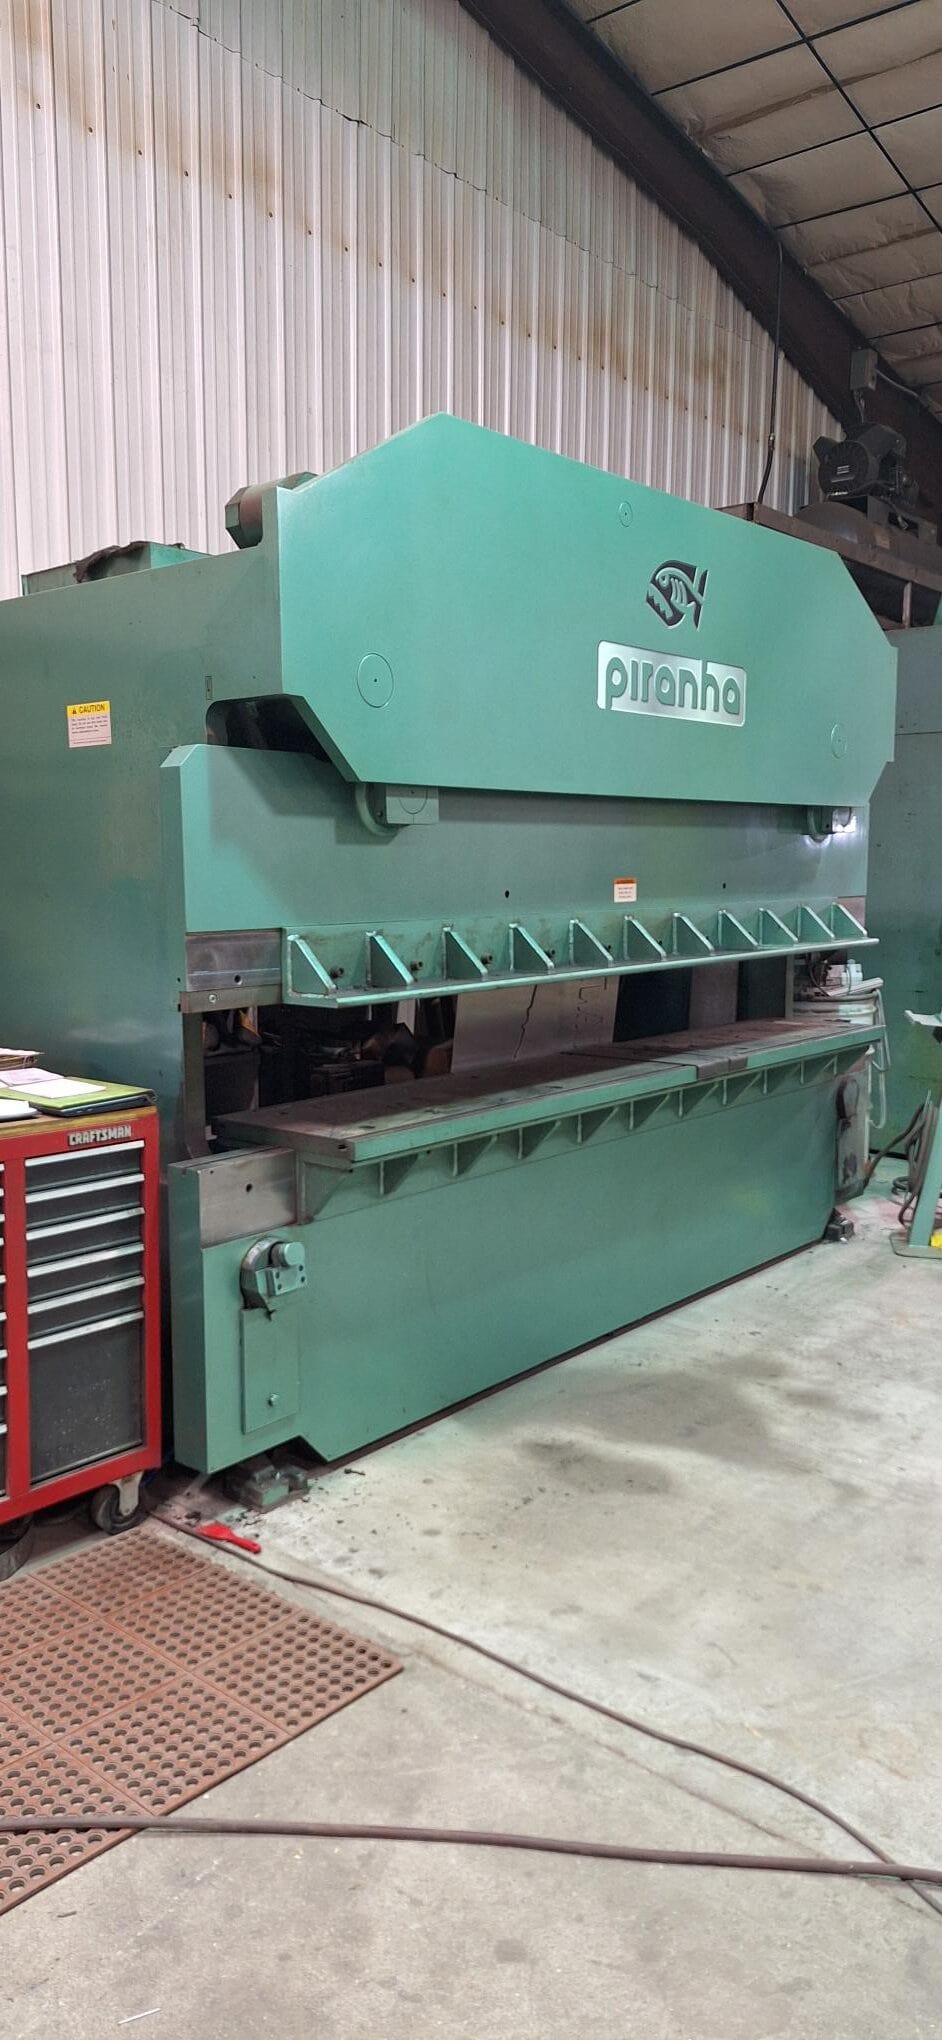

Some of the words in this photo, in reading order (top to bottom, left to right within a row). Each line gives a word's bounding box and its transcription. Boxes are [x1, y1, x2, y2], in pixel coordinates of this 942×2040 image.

[605, 656, 741, 715] piranha
[78, 704, 106, 714] CAUTION
[69, 1125, 132, 1146] CRAFTSMAN
